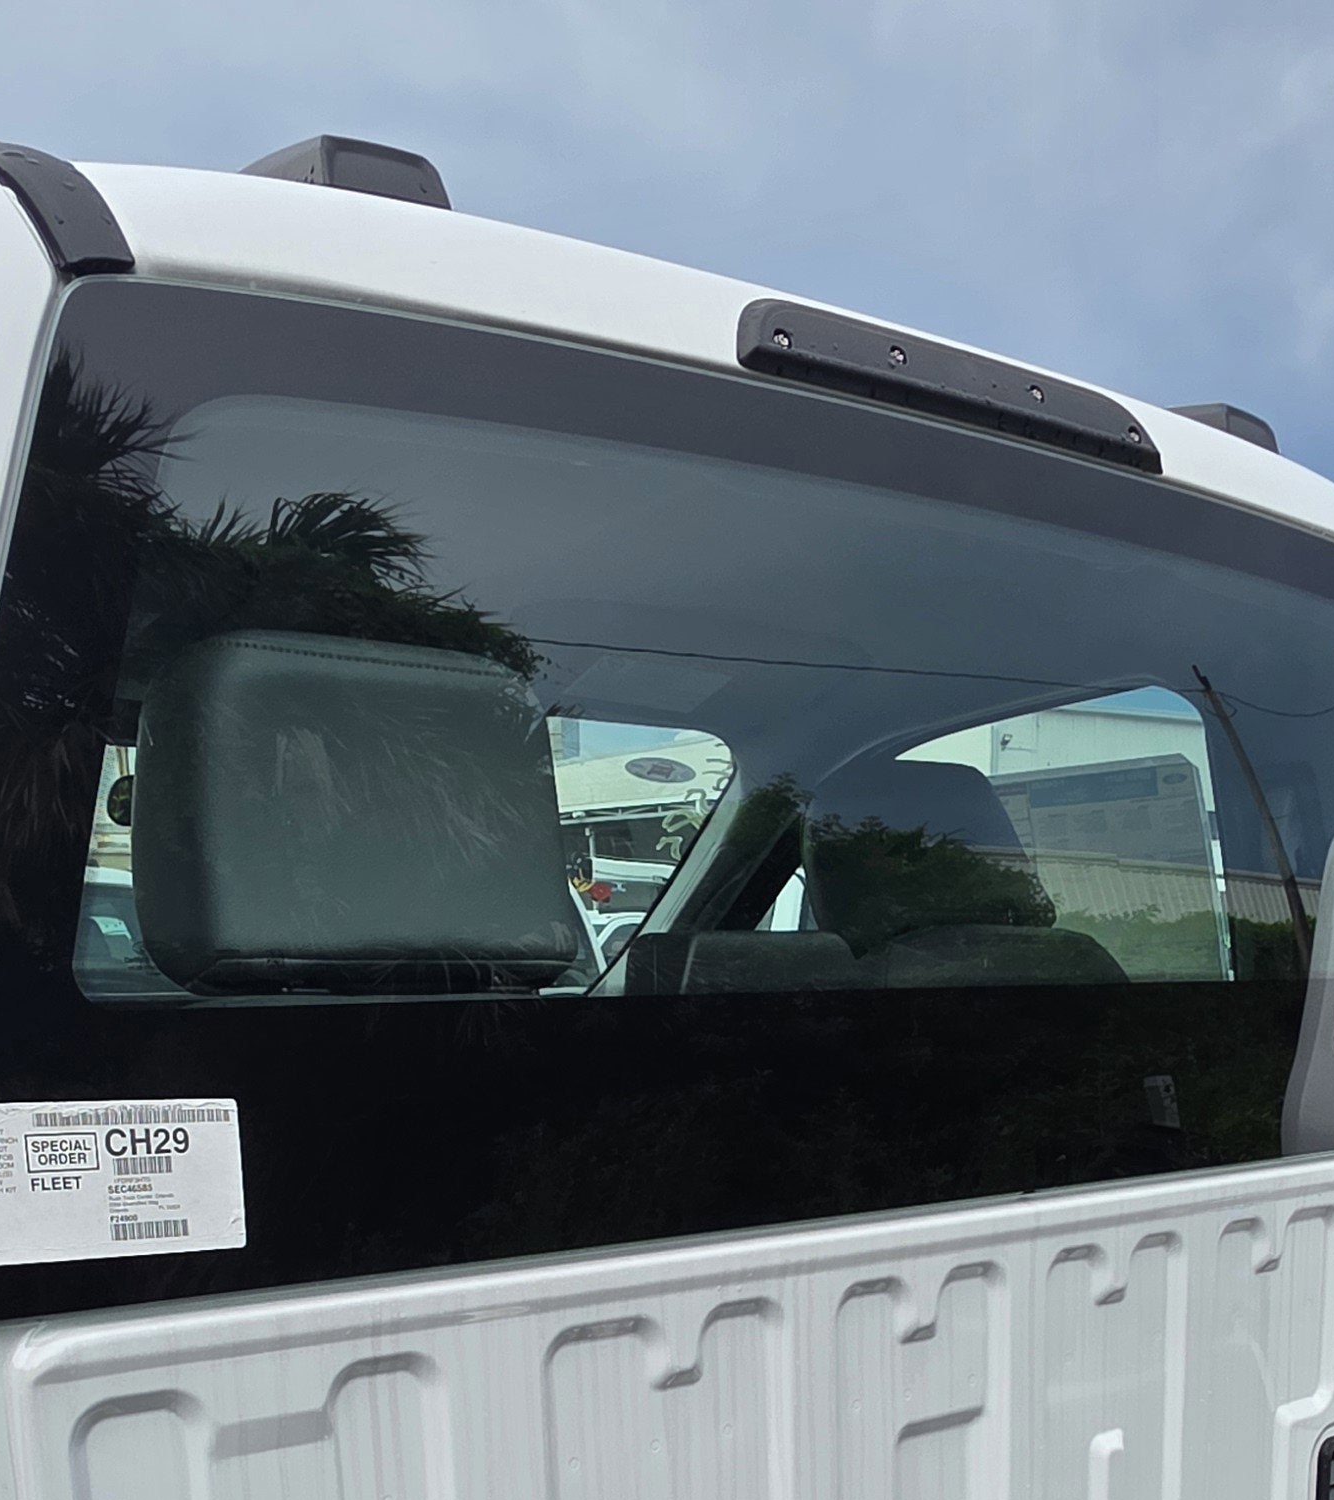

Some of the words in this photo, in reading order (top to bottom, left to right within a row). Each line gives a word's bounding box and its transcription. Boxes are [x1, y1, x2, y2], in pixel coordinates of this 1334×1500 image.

[31, 1138, 91, 1153] SPECIAL
[105, 1127, 190, 1157] CH29
[37, 1152, 87, 1166] ORDER
[31, 1175, 83, 1192] FLEET
